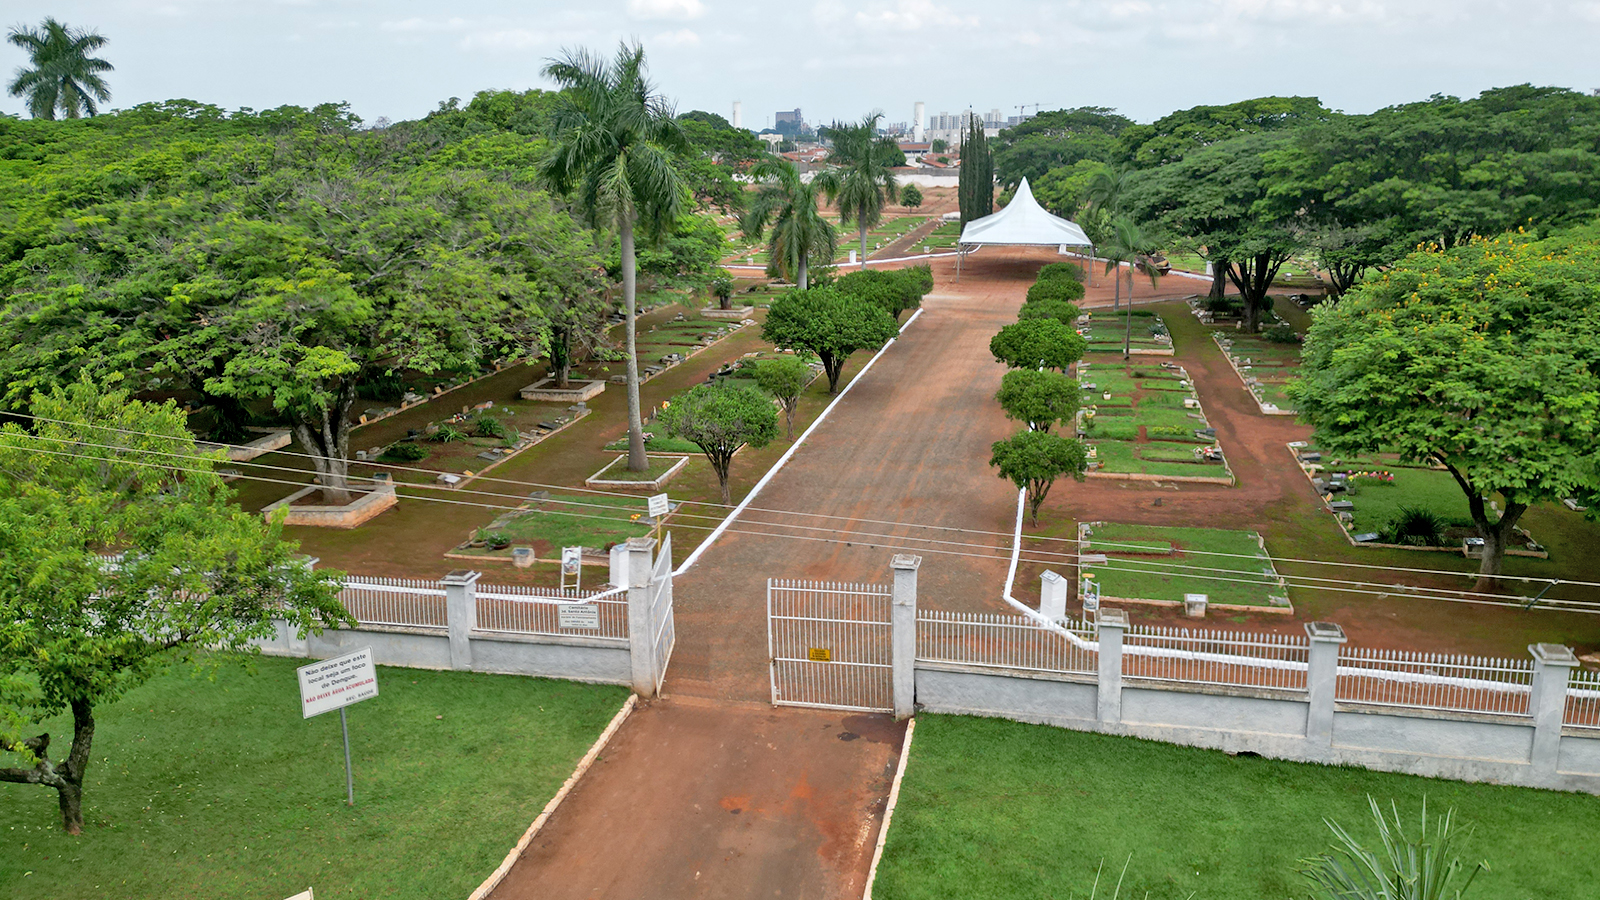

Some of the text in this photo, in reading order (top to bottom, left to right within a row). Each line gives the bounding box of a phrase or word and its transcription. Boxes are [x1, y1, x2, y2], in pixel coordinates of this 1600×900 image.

[306, 669, 318, 677] Não
[320, 663, 338, 672] deixe
[308, 675, 324, 684] local
[352, 662, 366, 671] foco
[317, 692, 331, 700] DEIXE
[346, 678, 374, 690] ACUMULADA
